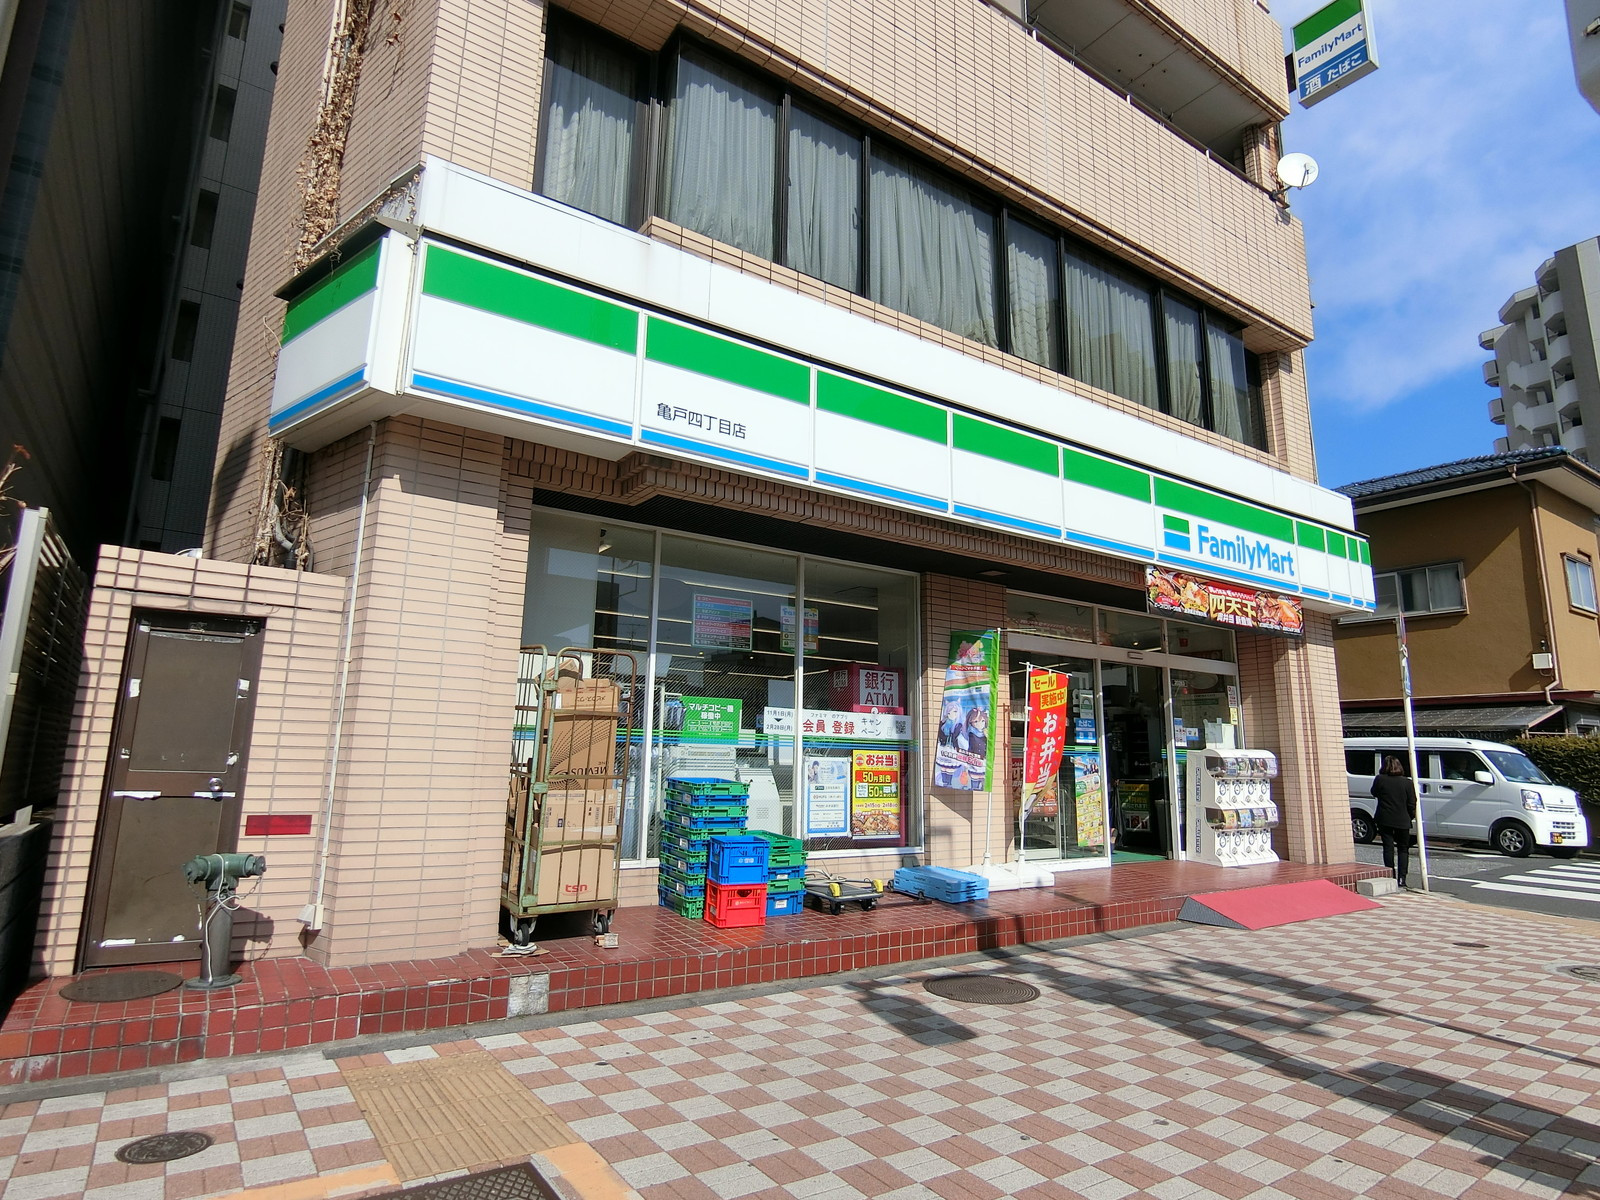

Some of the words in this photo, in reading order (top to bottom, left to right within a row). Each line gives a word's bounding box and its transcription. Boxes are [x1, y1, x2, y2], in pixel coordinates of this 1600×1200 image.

[1298, 23, 1363, 68] FamilyMart
[1305, 74, 1322, 95] 酒
[1327, 53, 1362, 81] たばこ
[657, 402, 746, 439] 亀戸四丁目店
[1197, 524, 1295, 577] FamilyMart
[864, 671, 895, 691] 銀行
[1033, 676, 1055, 690] セール
[864, 692, 894, 706] ATM
[802, 719, 826, 733] 会員
[832, 721, 855, 735] 登録
[861, 718, 882, 726] キャン
[866, 754, 893, 766] お弁当
[1033, 711, 1058, 789] お弁当
